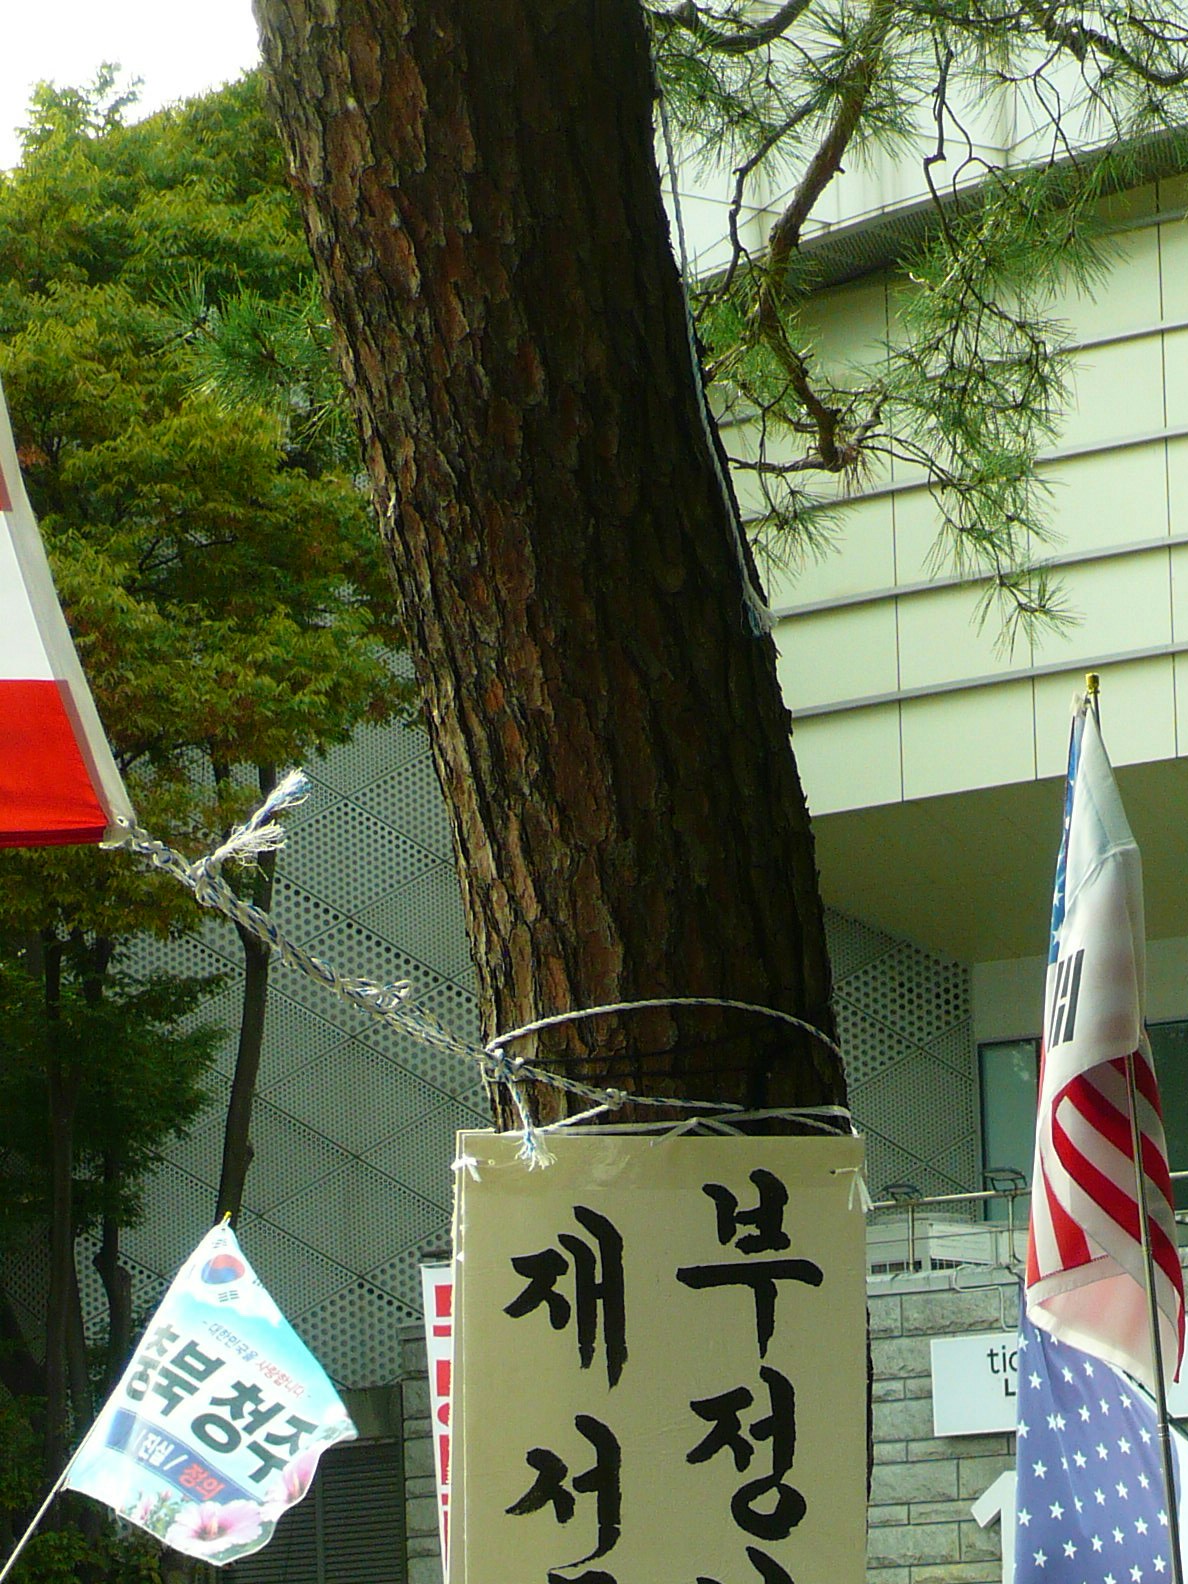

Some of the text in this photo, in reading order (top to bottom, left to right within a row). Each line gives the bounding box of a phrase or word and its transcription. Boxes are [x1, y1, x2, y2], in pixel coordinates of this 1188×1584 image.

[125, 1323, 320, 1484] 충북 청주
[178, 1462, 226, 1501] 정의
